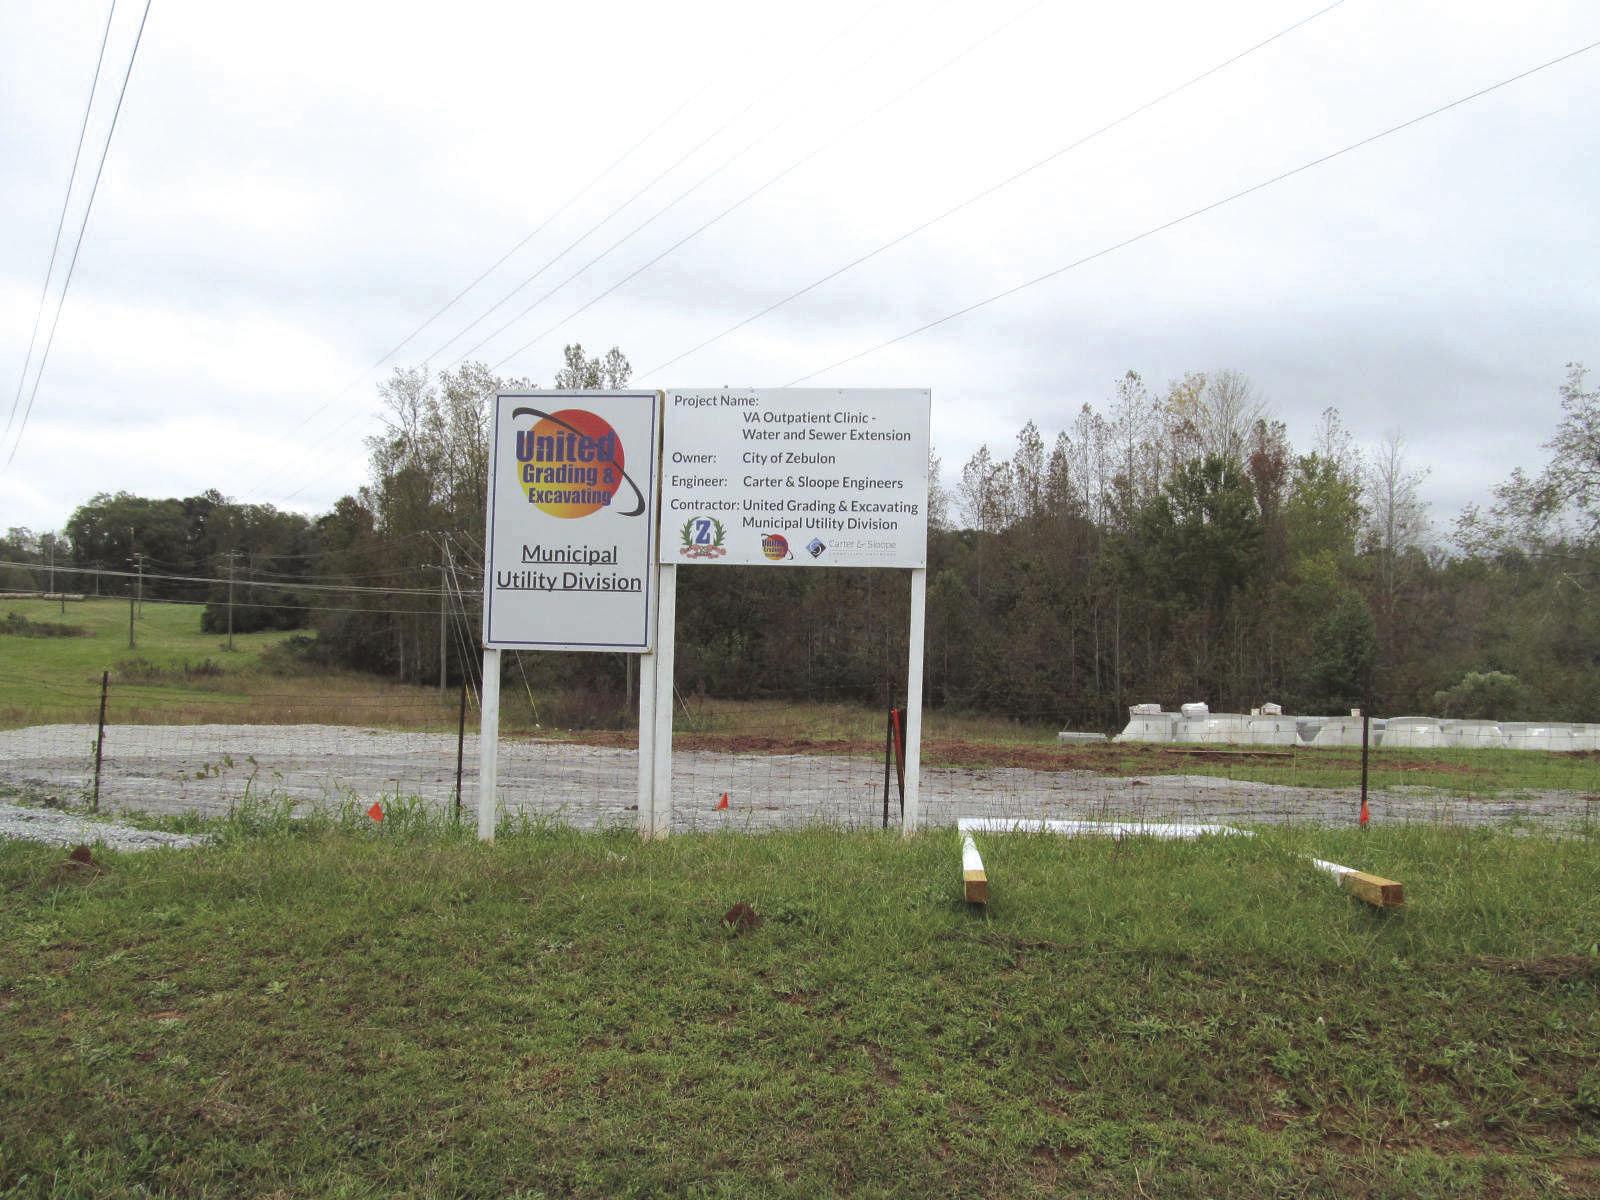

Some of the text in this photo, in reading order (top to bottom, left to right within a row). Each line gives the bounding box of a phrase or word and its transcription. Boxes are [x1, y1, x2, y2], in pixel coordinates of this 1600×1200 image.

[674, 395, 759, 408] Project Name:
[743, 411, 760, 423] VA
[763, 411, 831, 425] Outpatient
[834, 412, 869, 423] Clinic
[742, 428, 911, 441] Water and Sewer Extension
[515, 430, 616, 462] United
[672, 452, 717, 463] Owner:
[742, 452, 836, 465] City of Zebulon
[522, 463, 599, 485] Grading
[671, 475, 727, 488] Engineer:
[743, 475, 904, 490] Carter & Sloope Engineers
[528, 487, 612, 507] Excavating
[670, 498, 739, 510] Contractor:
[743, 499, 919, 515] United Grading & Excavating
[742, 517, 898, 531] Municipal Utility Division
[695, 520, 711, 544] Z
[522, 544, 618, 566] Municipal
[497, 570, 642, 592] Utility Division
